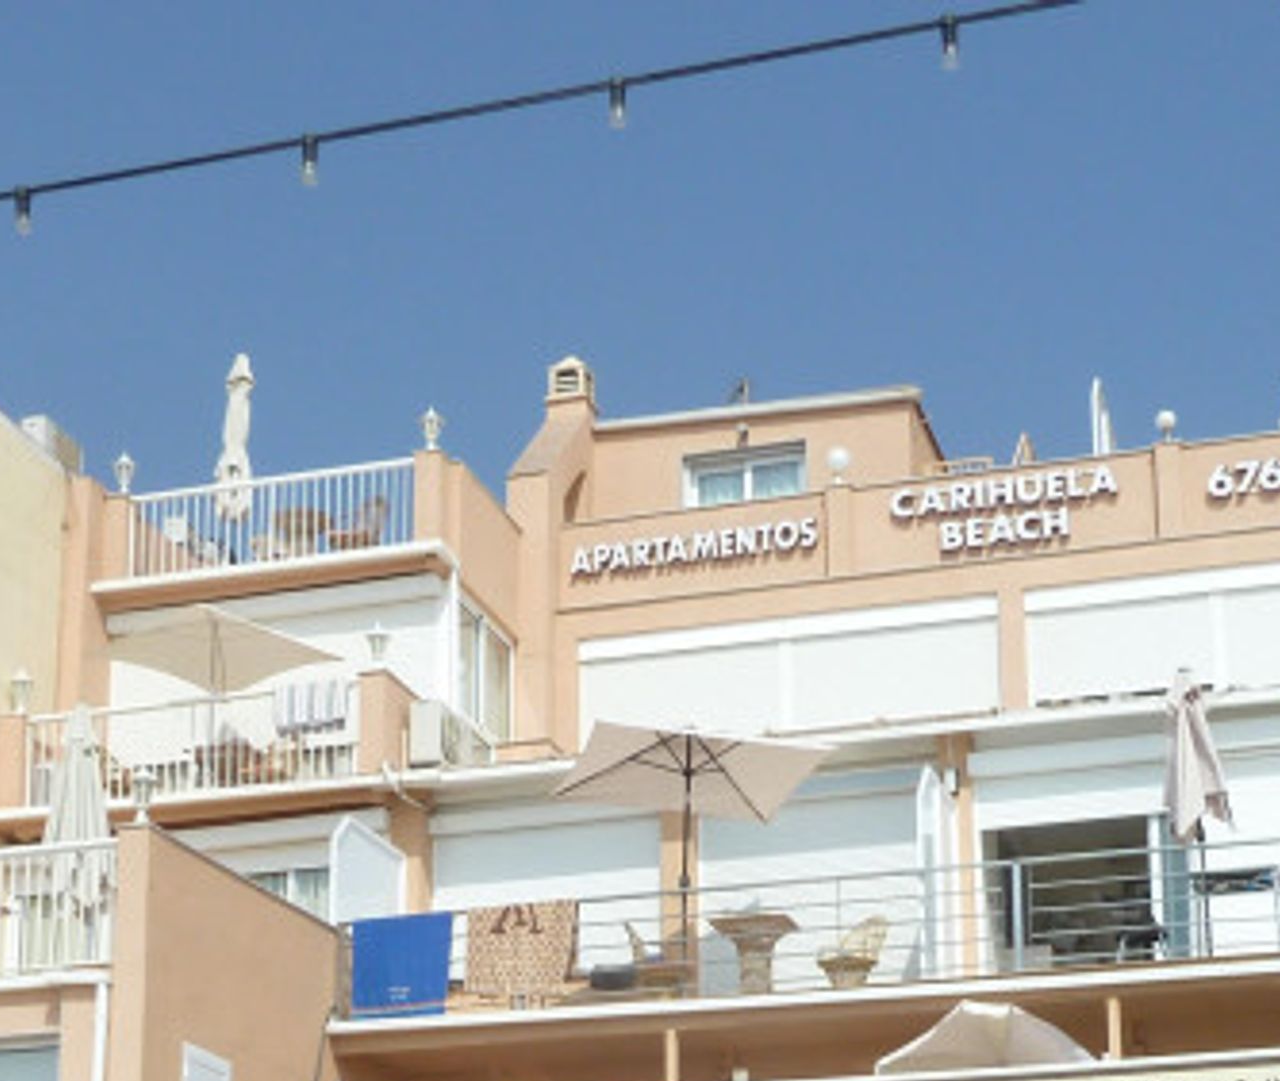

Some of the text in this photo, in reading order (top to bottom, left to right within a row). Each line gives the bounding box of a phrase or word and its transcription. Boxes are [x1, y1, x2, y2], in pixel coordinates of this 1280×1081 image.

[890, 465, 1117, 518] CARIHUELA
[570, 517, 818, 575] APARTAMENTOS
[940, 507, 1070, 551] BEACH
